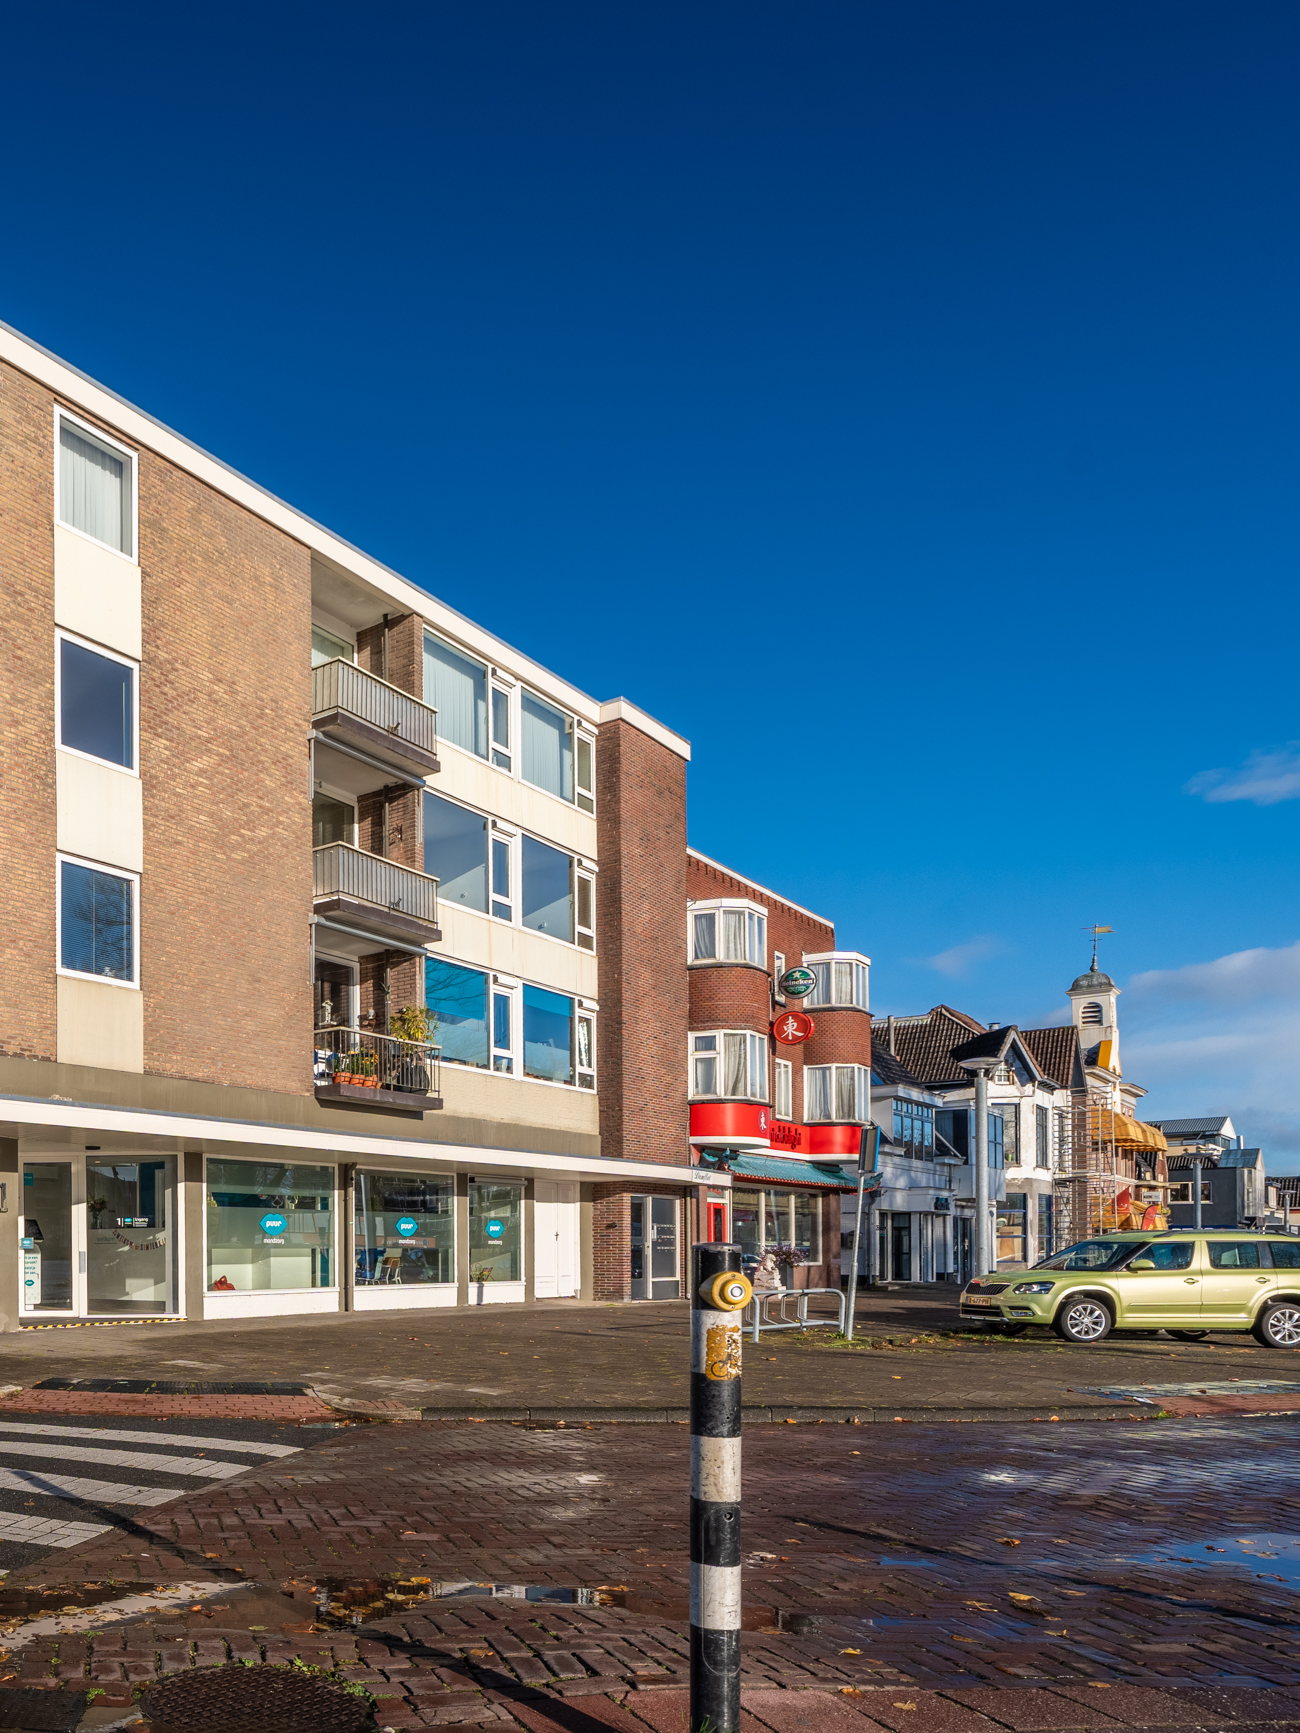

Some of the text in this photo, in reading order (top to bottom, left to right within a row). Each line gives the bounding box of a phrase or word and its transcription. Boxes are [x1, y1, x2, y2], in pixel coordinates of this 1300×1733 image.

[781, 979, 813, 987] Heineken
[781, 1016, 804, 1040] 東
[0, 1182, 8, 1213] 1
[265, 1220, 283, 1228] puur
[263, 1237, 285, 1245] mondzorg
